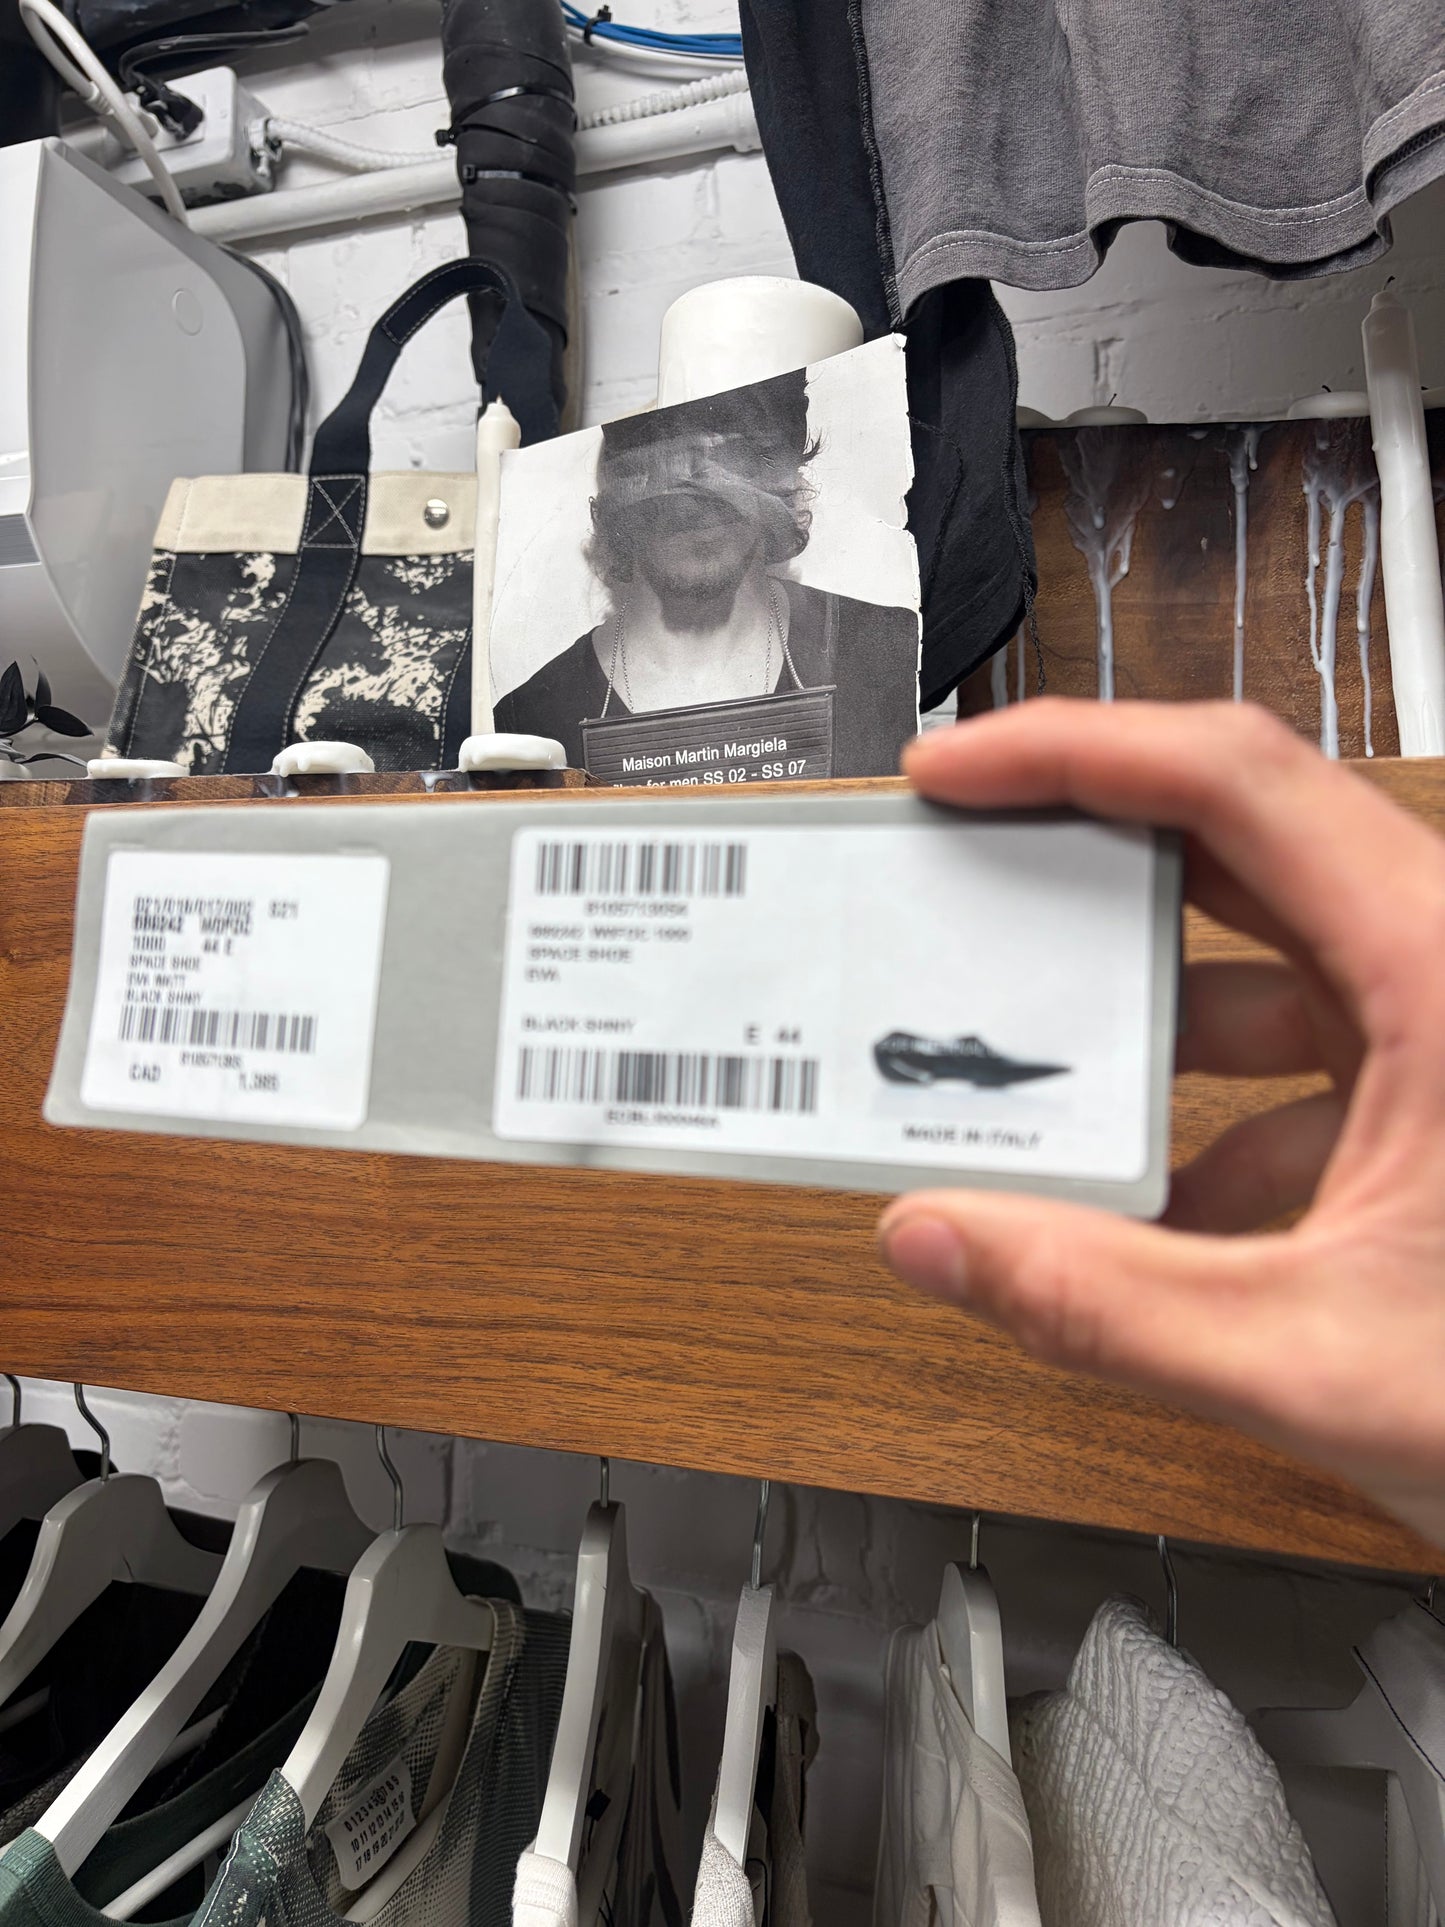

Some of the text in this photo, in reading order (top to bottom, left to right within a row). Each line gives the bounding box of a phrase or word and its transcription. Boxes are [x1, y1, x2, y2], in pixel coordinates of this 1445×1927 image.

[622, 737, 788, 772] Maison Martin Margiela
[703, 771, 724, 785] SS
[729, 768, 747, 783] 02
[762, 762, 783, 779] SS
[788, 759, 807, 776] 07
[355, 1812, 365, 1822] 2
[360, 1806, 370, 1817] 3
[351, 1838, 360, 1853] 10
[360, 1831, 368, 1845] 11
[368, 1822, 377, 1837] 12
[383, 1806, 392, 1819] 14
